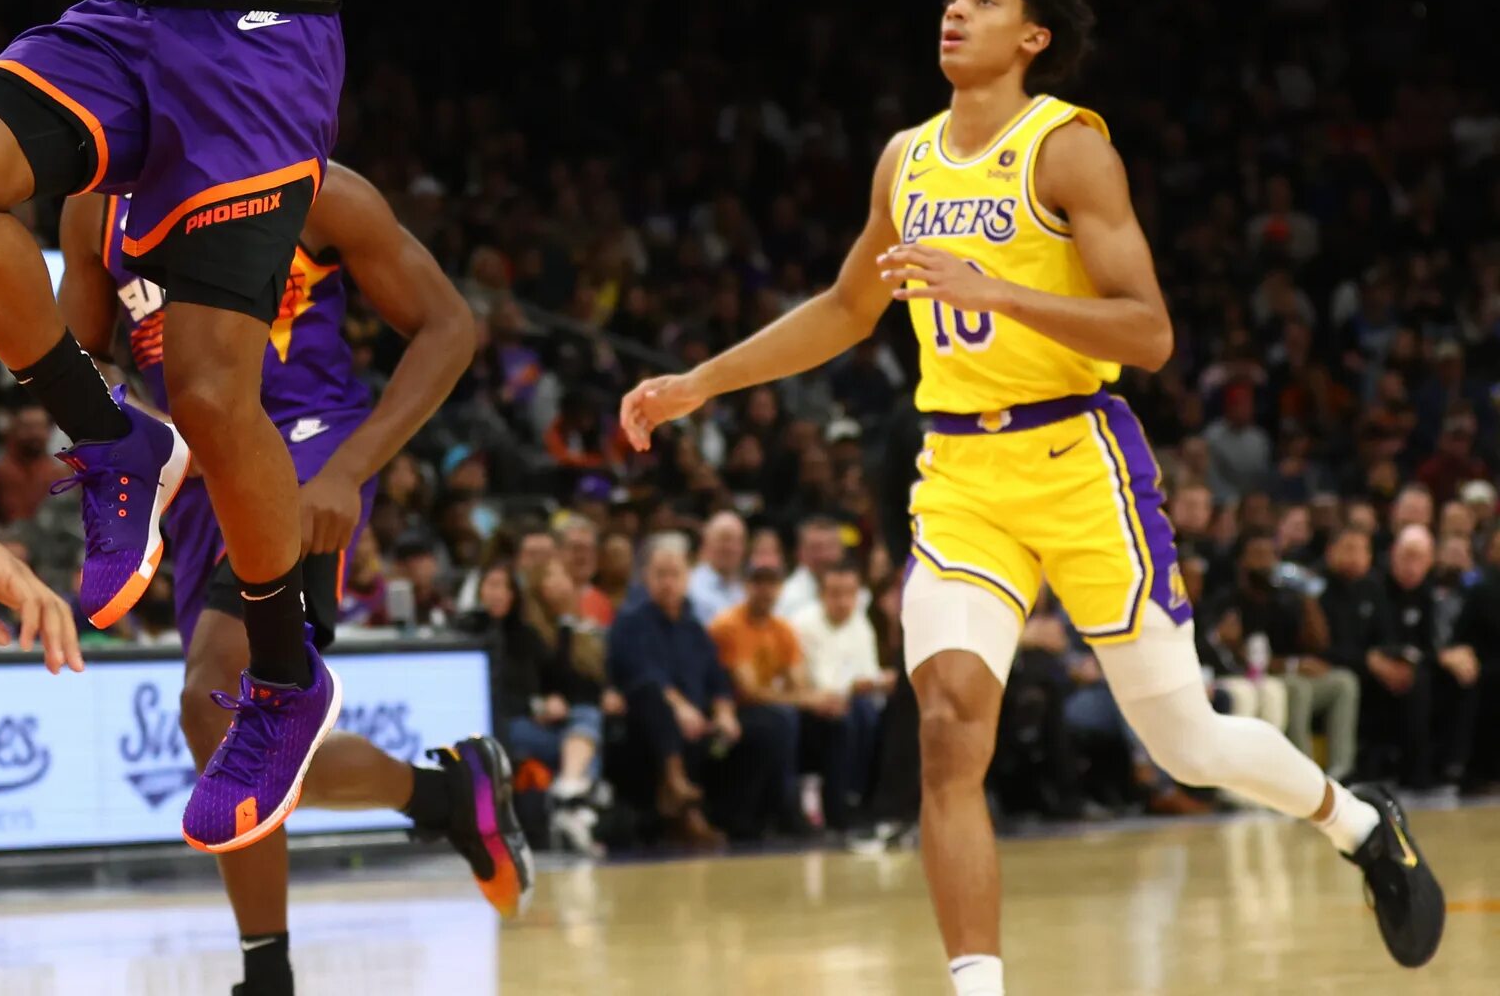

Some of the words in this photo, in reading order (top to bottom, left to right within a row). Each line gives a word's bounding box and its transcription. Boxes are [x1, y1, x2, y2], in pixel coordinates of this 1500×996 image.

[246, 9, 281, 23] NIKE
[185, 191, 283, 235] PHOENIX
[901, 191, 1017, 245] LAKERS
